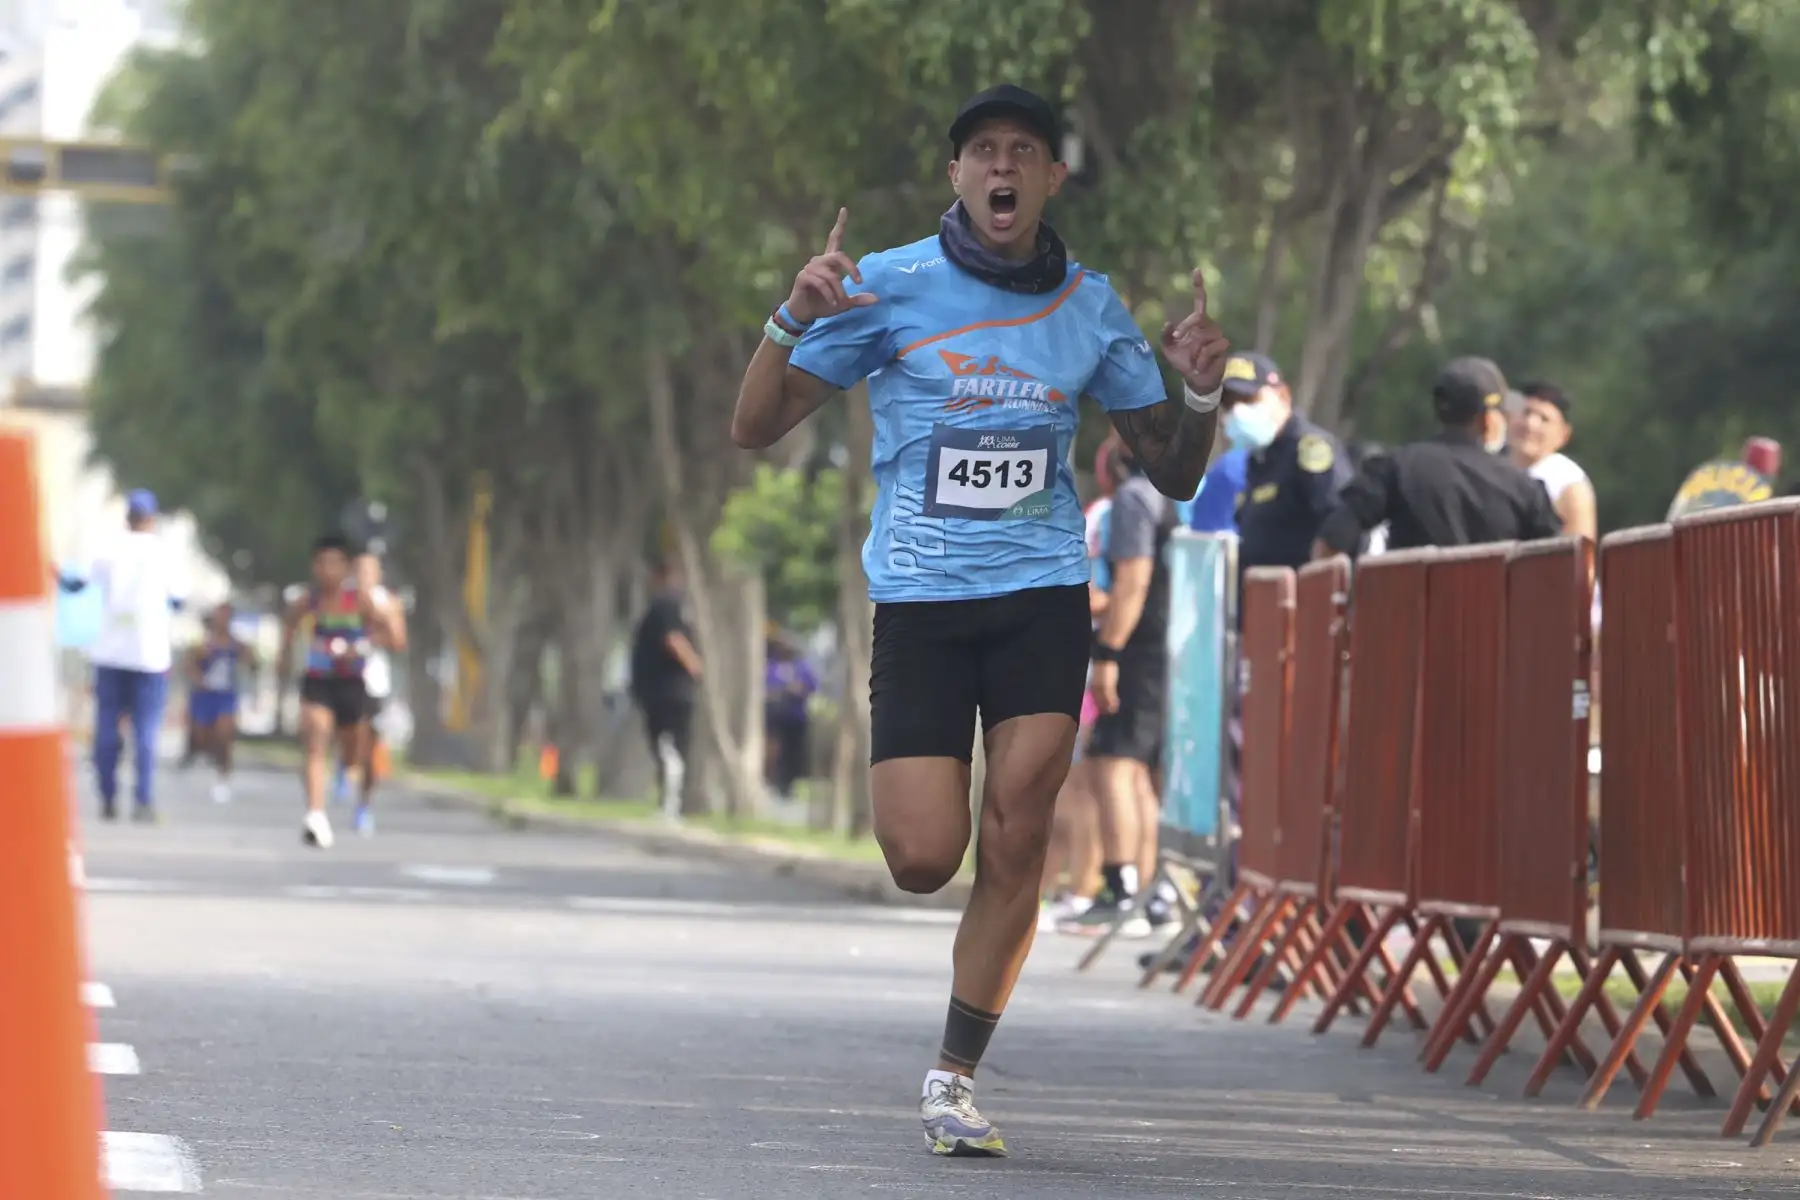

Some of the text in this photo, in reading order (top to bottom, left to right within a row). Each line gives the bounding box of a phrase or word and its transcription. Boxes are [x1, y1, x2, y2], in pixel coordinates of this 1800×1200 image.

[952, 378, 1050, 400] FARTLEK
[996, 441, 1021, 449] CORRE
[948, 459, 1033, 488] 4513
[1027, 507, 1049, 516] LIMA
